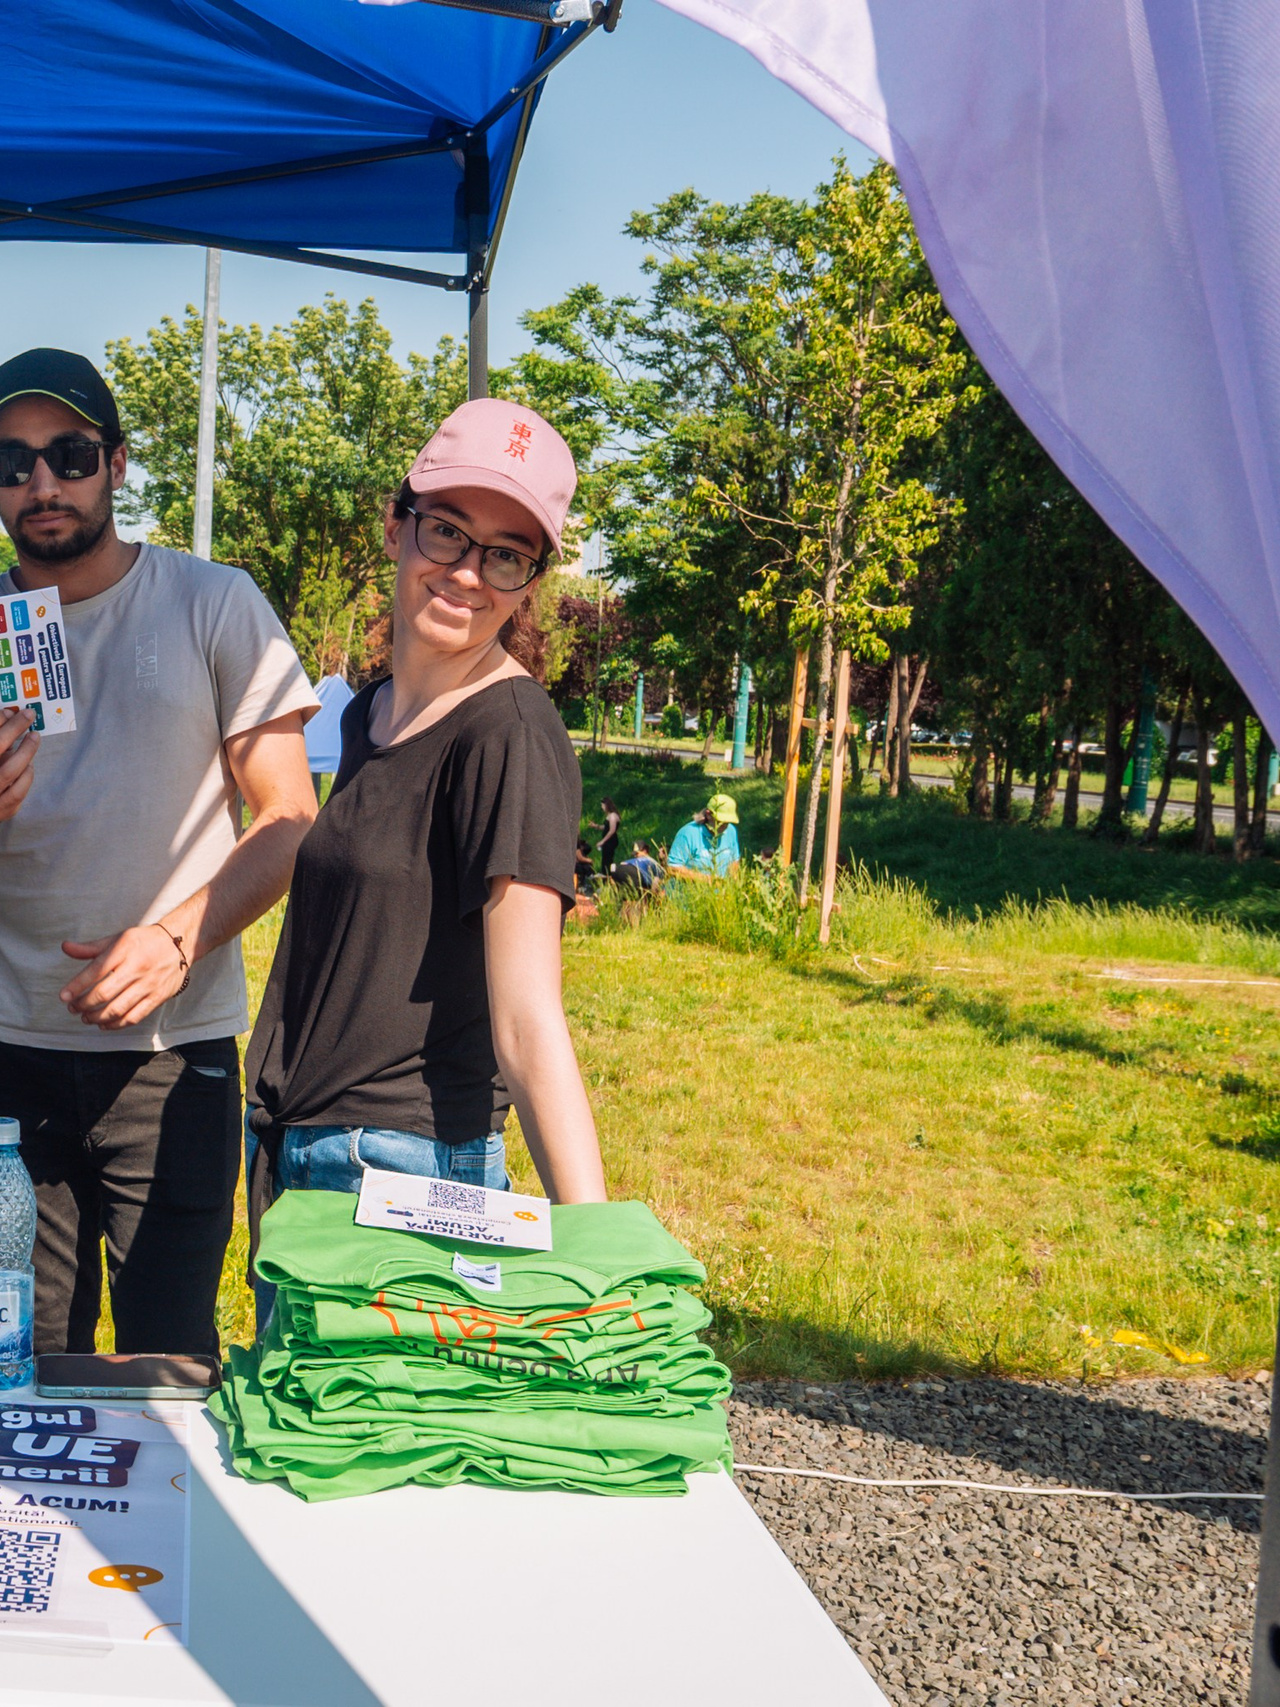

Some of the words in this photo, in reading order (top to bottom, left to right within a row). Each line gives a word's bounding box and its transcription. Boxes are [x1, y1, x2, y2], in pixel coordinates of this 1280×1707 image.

[504, 419, 536, 462] 東京
[57, 664, 68, 698] Europene
[405, 1221, 505, 1243] PARTICIPĂ
[428, 1218, 488, 1232] ACUM!
[12, 1432, 122, 1464] UE
[15, 1493, 130, 1513] ACUM!
